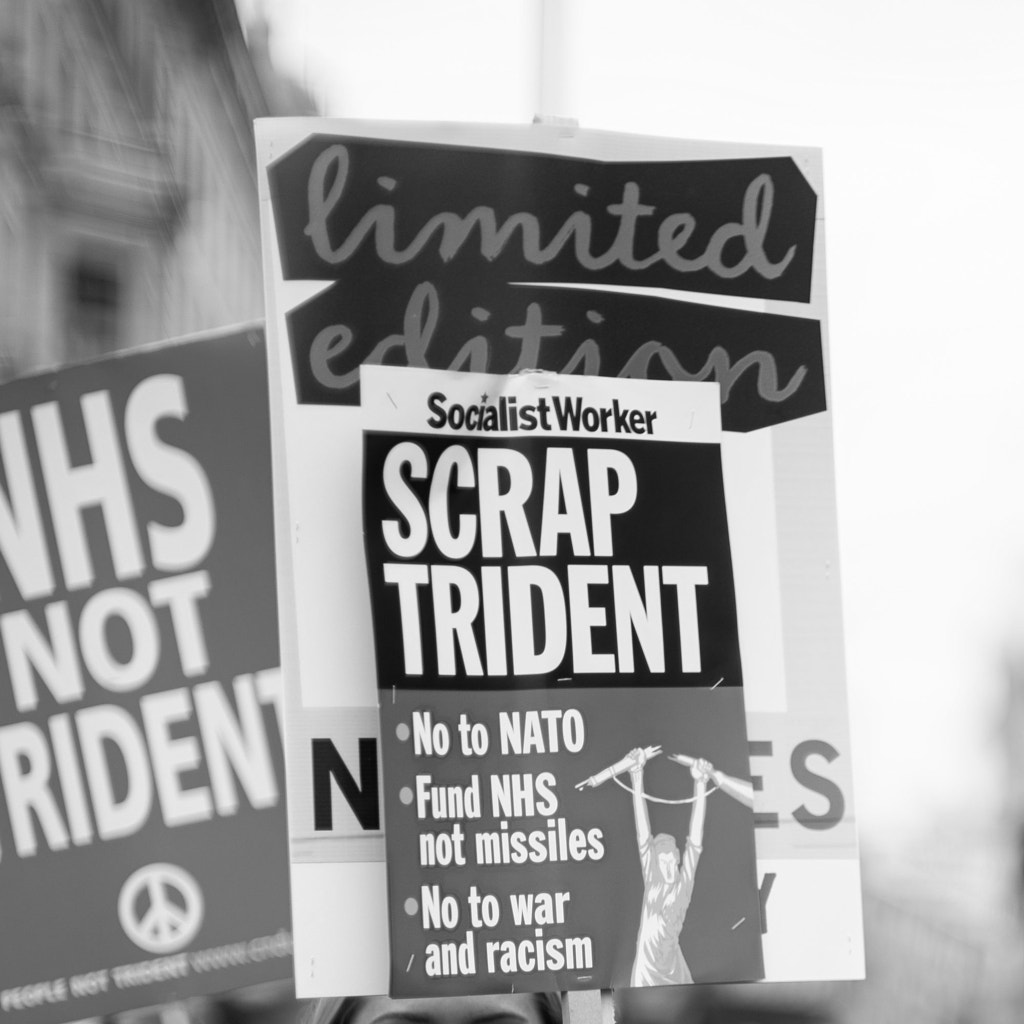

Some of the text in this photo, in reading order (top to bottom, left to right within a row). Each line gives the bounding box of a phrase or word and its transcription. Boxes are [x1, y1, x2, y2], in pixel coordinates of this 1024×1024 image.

[305, 144, 796, 279] limited
[0, 373, 217, 601] NHS
[381, 442, 638, 559] SCRAP
[0, 570, 211, 713] NOT
[383, 563, 709, 677] TRIDENT
[0, 667, 284, 858] RIDEN
[412, 708, 585, 755] No to NATO
[416, 772, 559, 819] Fund NHS
[420, 818, 605, 866] not missiles
[421, 885, 570, 930] No to war
[425, 929, 593, 977] and racism
